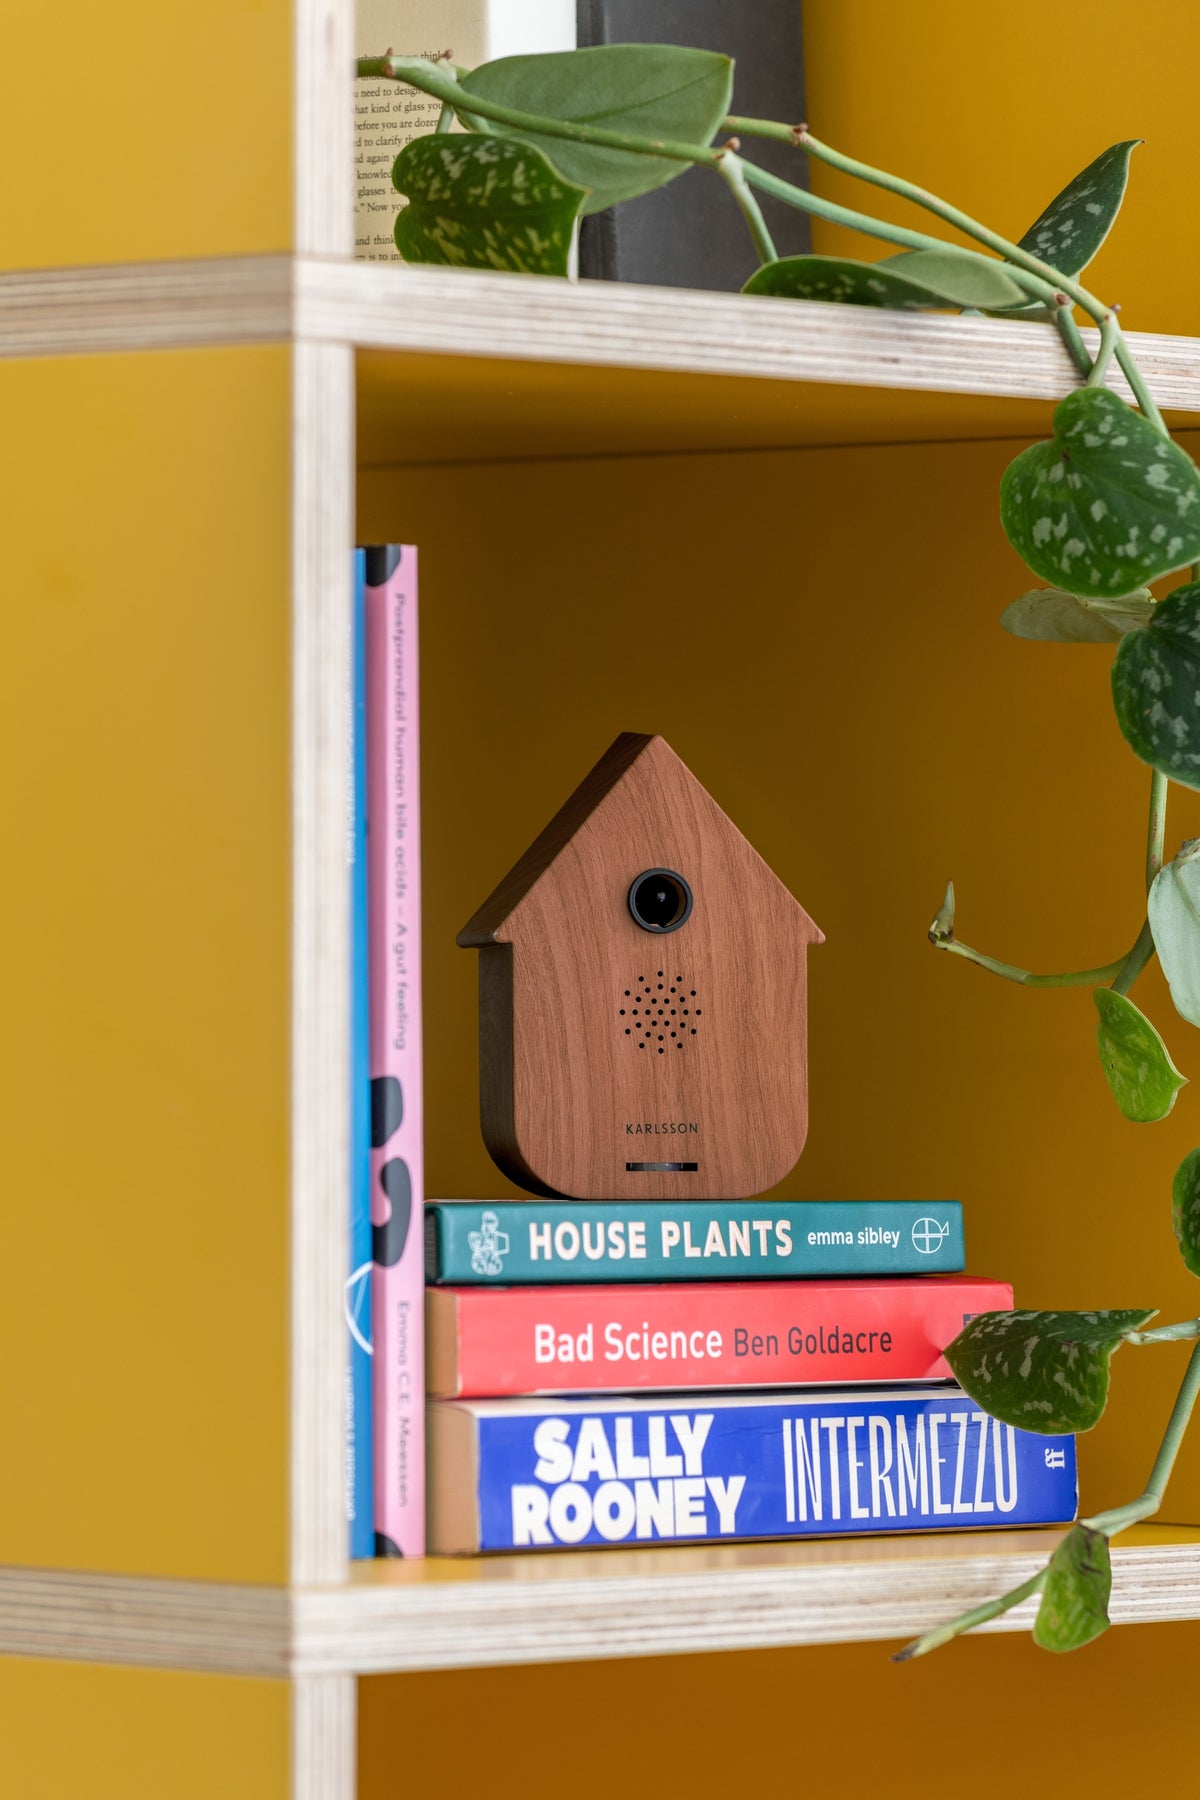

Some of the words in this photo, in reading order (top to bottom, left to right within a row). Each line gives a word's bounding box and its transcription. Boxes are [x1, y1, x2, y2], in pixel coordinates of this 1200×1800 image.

[353, 103, 369, 115] hat
[370, 103, 390, 114] kind
[392, 101, 403, 112] of
[404, 101, 425, 114] glass
[360, 86, 381, 97] need
[383, 88, 392, 96] to
[353, 120, 380, 131] before
[381, 121, 398, 132] you
[399, 120, 413, 129] are
[364, 138, 374, 147] to
[376, 134, 403, 147] clarify
[366, 153, 390, 166] again
[357, 185, 387, 199] glasses
[367, 202, 388, 213] Now
[368, 252, 377, 261] is
[378, 253, 388, 261] to
[393, 592, 407, 722] Postprandial
[394, 726, 406, 799] human
[394, 802, 408, 840] bile
[394, 845, 408, 898] acids
[395, 922, 408, 937] A
[391, 942, 408, 976] gut
[391, 980, 410, 1051] feeling
[626, 1123, 698, 1134] KARLSSON
[528, 1221, 647, 1261] HOUSE
[661, 1219, 793, 1258] PLANTS
[807, 1231, 854, 1246] emma
[857, 1226, 901, 1249] sibley
[396, 1300, 411, 1367] Emma
[534, 1323, 594, 1364] Bad
[604, 1322, 723, 1361] Science
[734, 1328, 779, 1357] Ben
[788, 1325, 892, 1355] Goldacre
[397, 1416, 411, 1508] Meessen
[533, 1414, 715, 1485] SALLY
[782, 1411, 1018, 1523] INTERMEZZO
[511, 1475, 747, 1547] ROONEY
